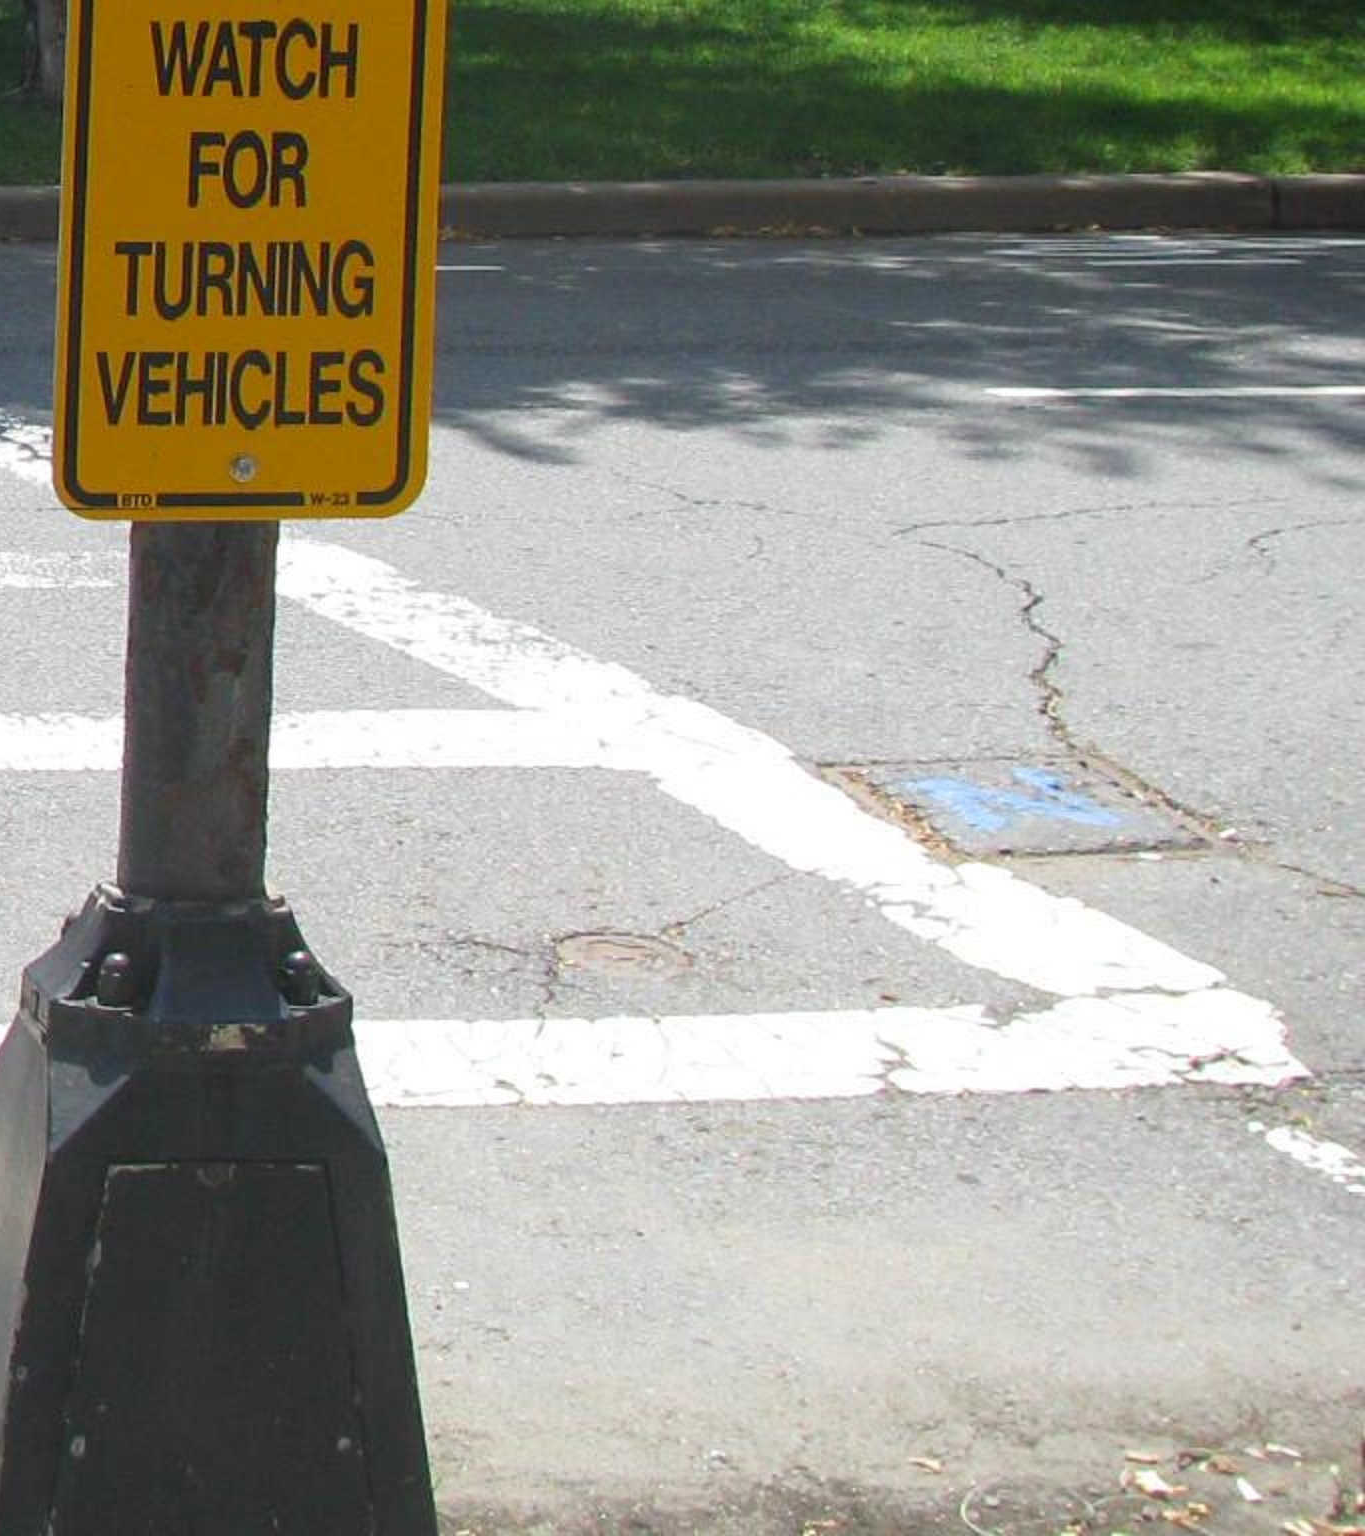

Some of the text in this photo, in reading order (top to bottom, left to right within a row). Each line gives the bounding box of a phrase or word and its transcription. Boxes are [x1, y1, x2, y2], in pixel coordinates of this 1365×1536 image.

[149, 18, 359, 101] WATCH
[188, 129, 308, 209] FOR
[114, 240, 375, 320] TURNING
[96, 349, 386, 431] VEHICLES
